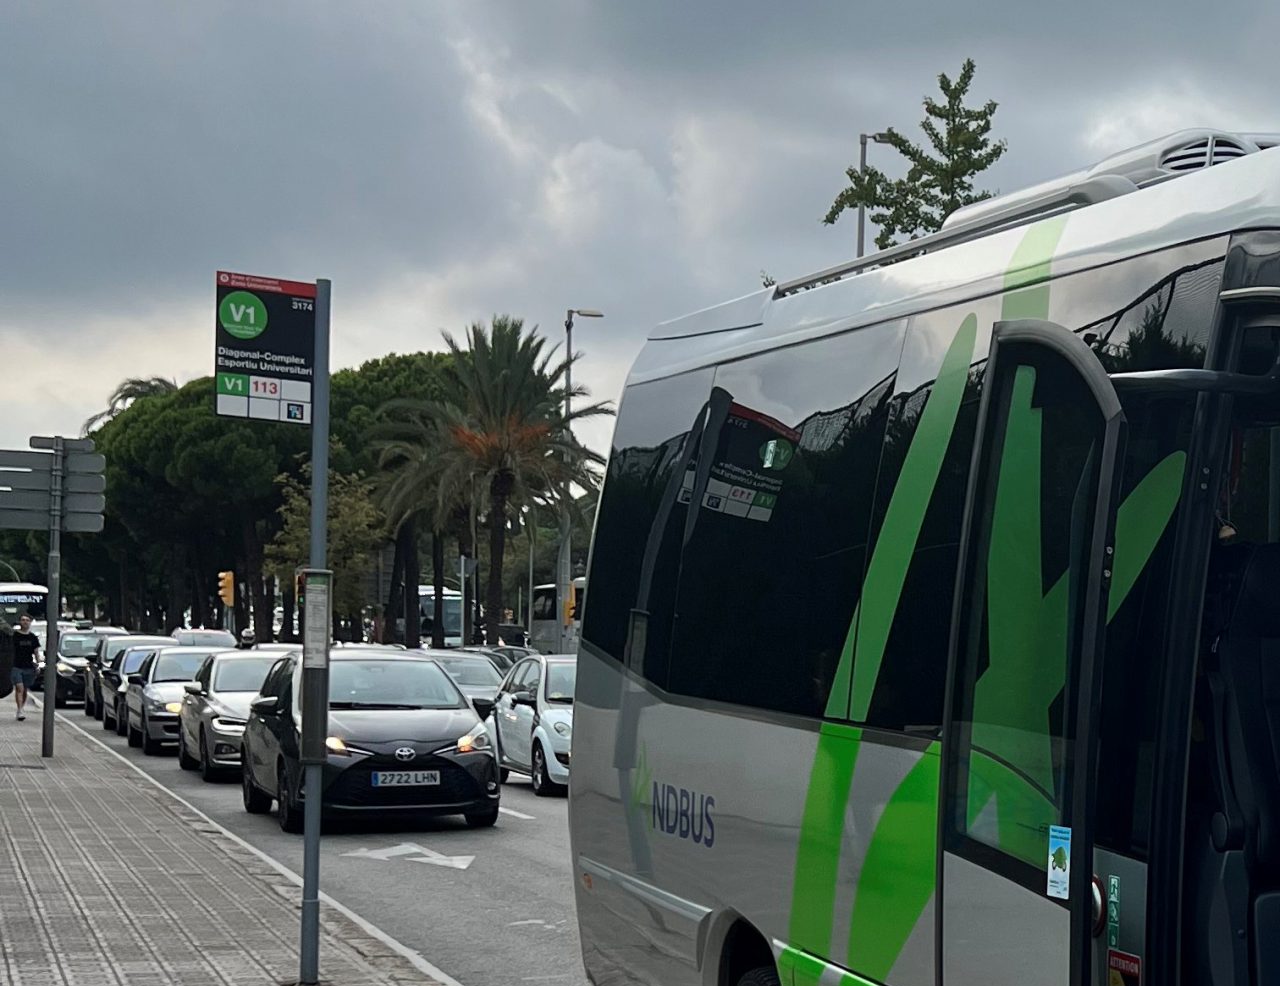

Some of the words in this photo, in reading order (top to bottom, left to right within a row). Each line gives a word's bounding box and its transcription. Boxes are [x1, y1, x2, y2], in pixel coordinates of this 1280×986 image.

[292, 301, 313, 311] 3174
[229, 303, 255, 324] V1
[218, 356, 258, 369] Esportiu
[260, 361, 312, 375] Universitari
[224, 376, 242, 391] V1
[253, 380, 278, 394] 113
[380, 773, 411, 784] 2722
[414, 772, 438, 783] LHN
